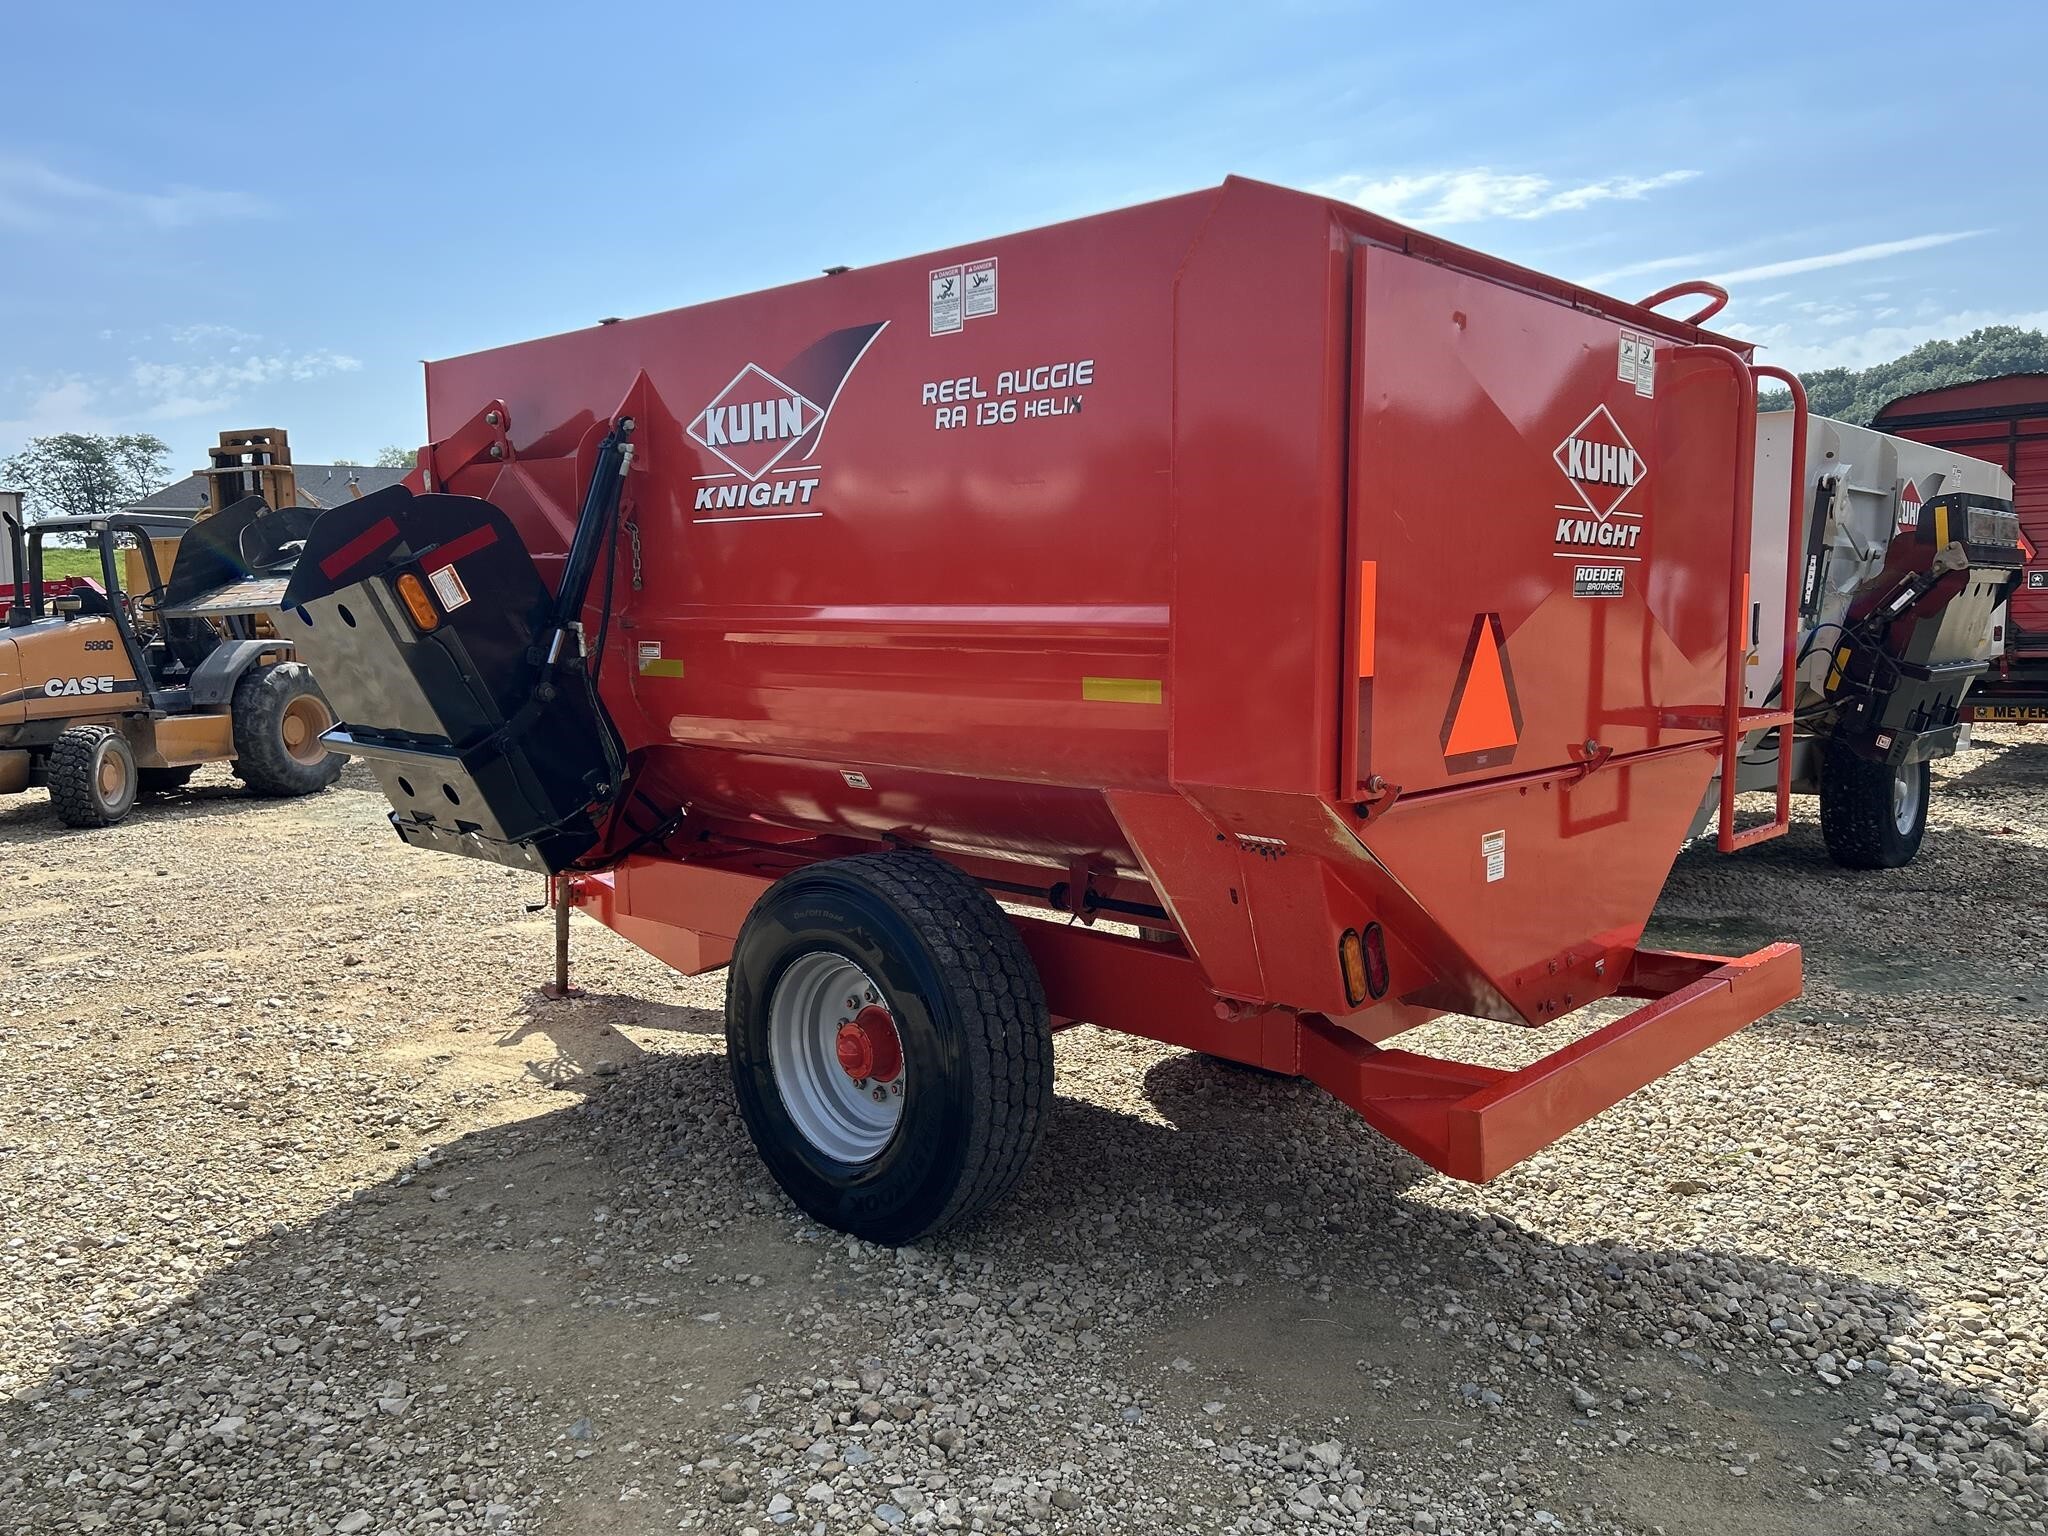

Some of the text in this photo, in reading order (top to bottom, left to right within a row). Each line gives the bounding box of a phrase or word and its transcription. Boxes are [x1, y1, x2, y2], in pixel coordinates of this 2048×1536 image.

[922, 359, 1095, 405] REEL AUGGIE
[705, 396, 803, 446] KUHN
[935, 394, 1083, 430] RA 136 HELIX
[1568, 437, 1635, 487] KUHN
[694, 478, 819, 511] KNIGHT
[1555, 518, 1641, 548] KNIGHT
[1576, 567, 1624, 582] ROEDER
[1586, 582, 1620, 591] BROTHERS
[84, 640, 114, 651] 588G
[44, 675, 115, 697] CASE
